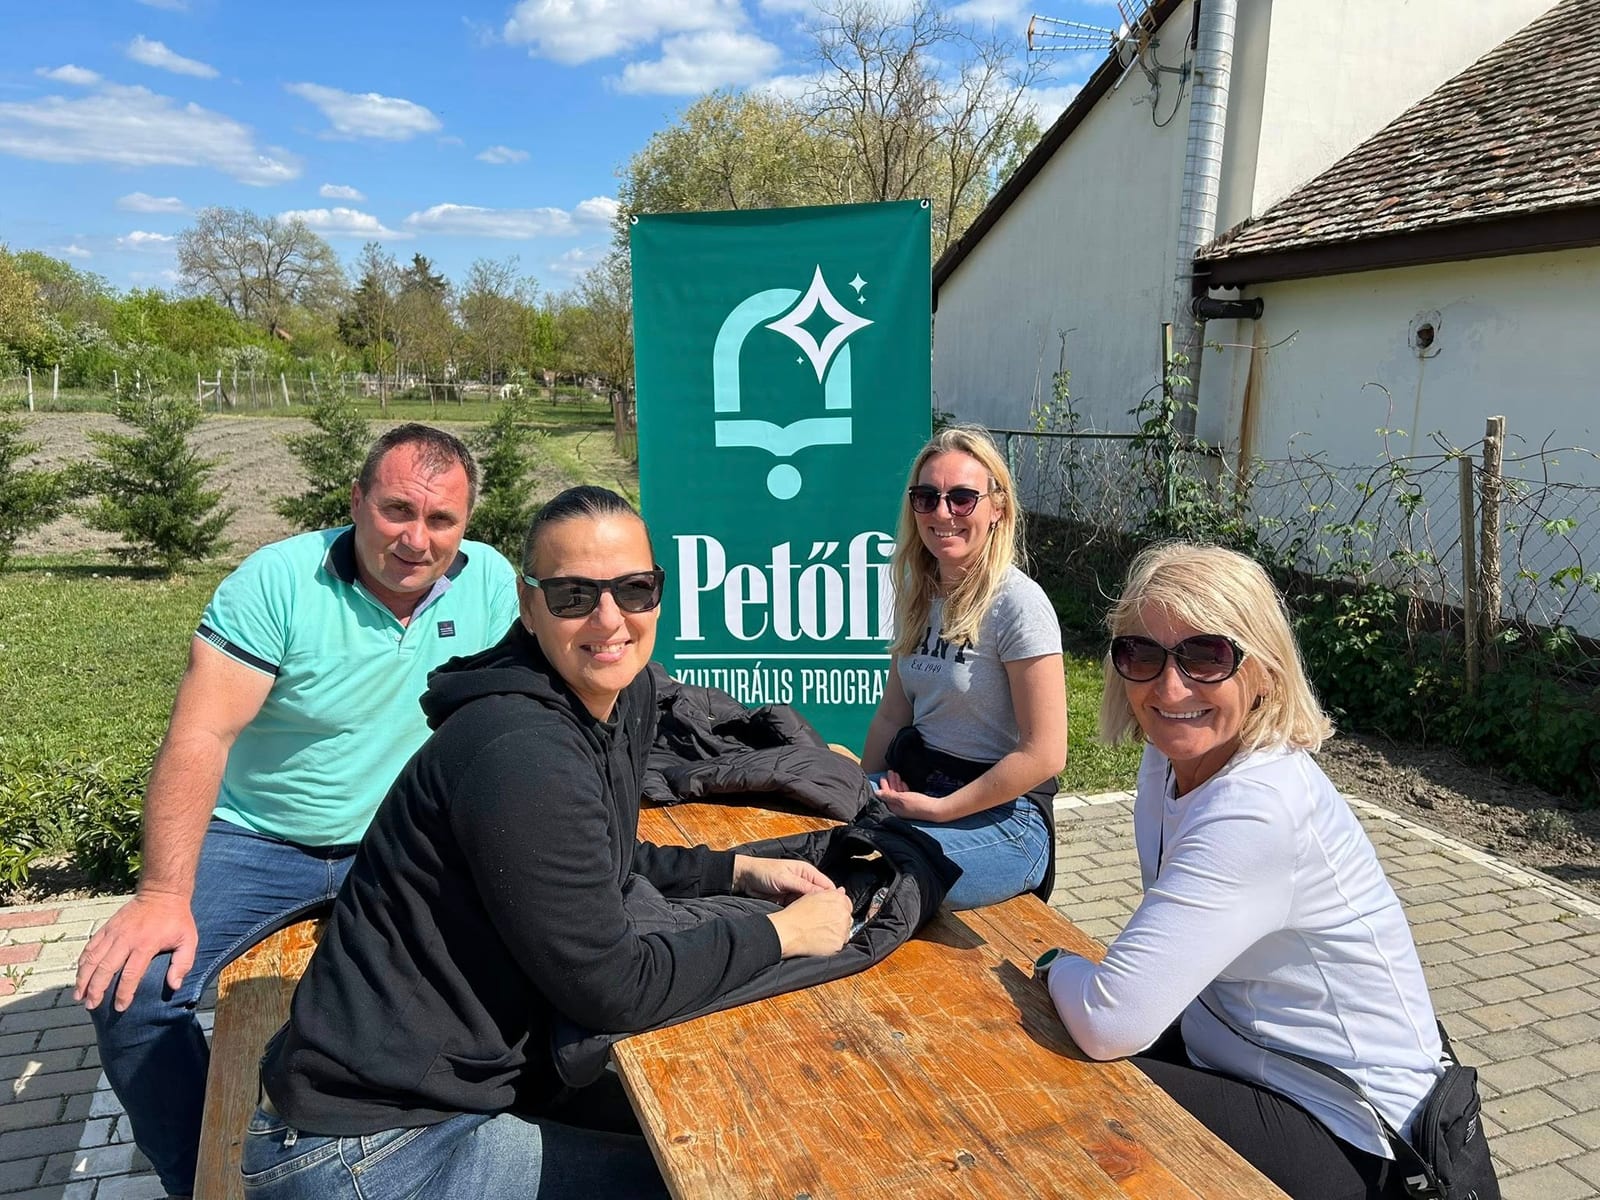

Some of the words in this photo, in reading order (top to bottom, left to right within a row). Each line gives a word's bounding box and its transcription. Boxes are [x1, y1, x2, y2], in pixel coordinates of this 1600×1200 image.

[672, 531, 897, 641] Petőfi
[924, 663, 942, 673] 1949
[800, 669, 890, 705] PROGRA
